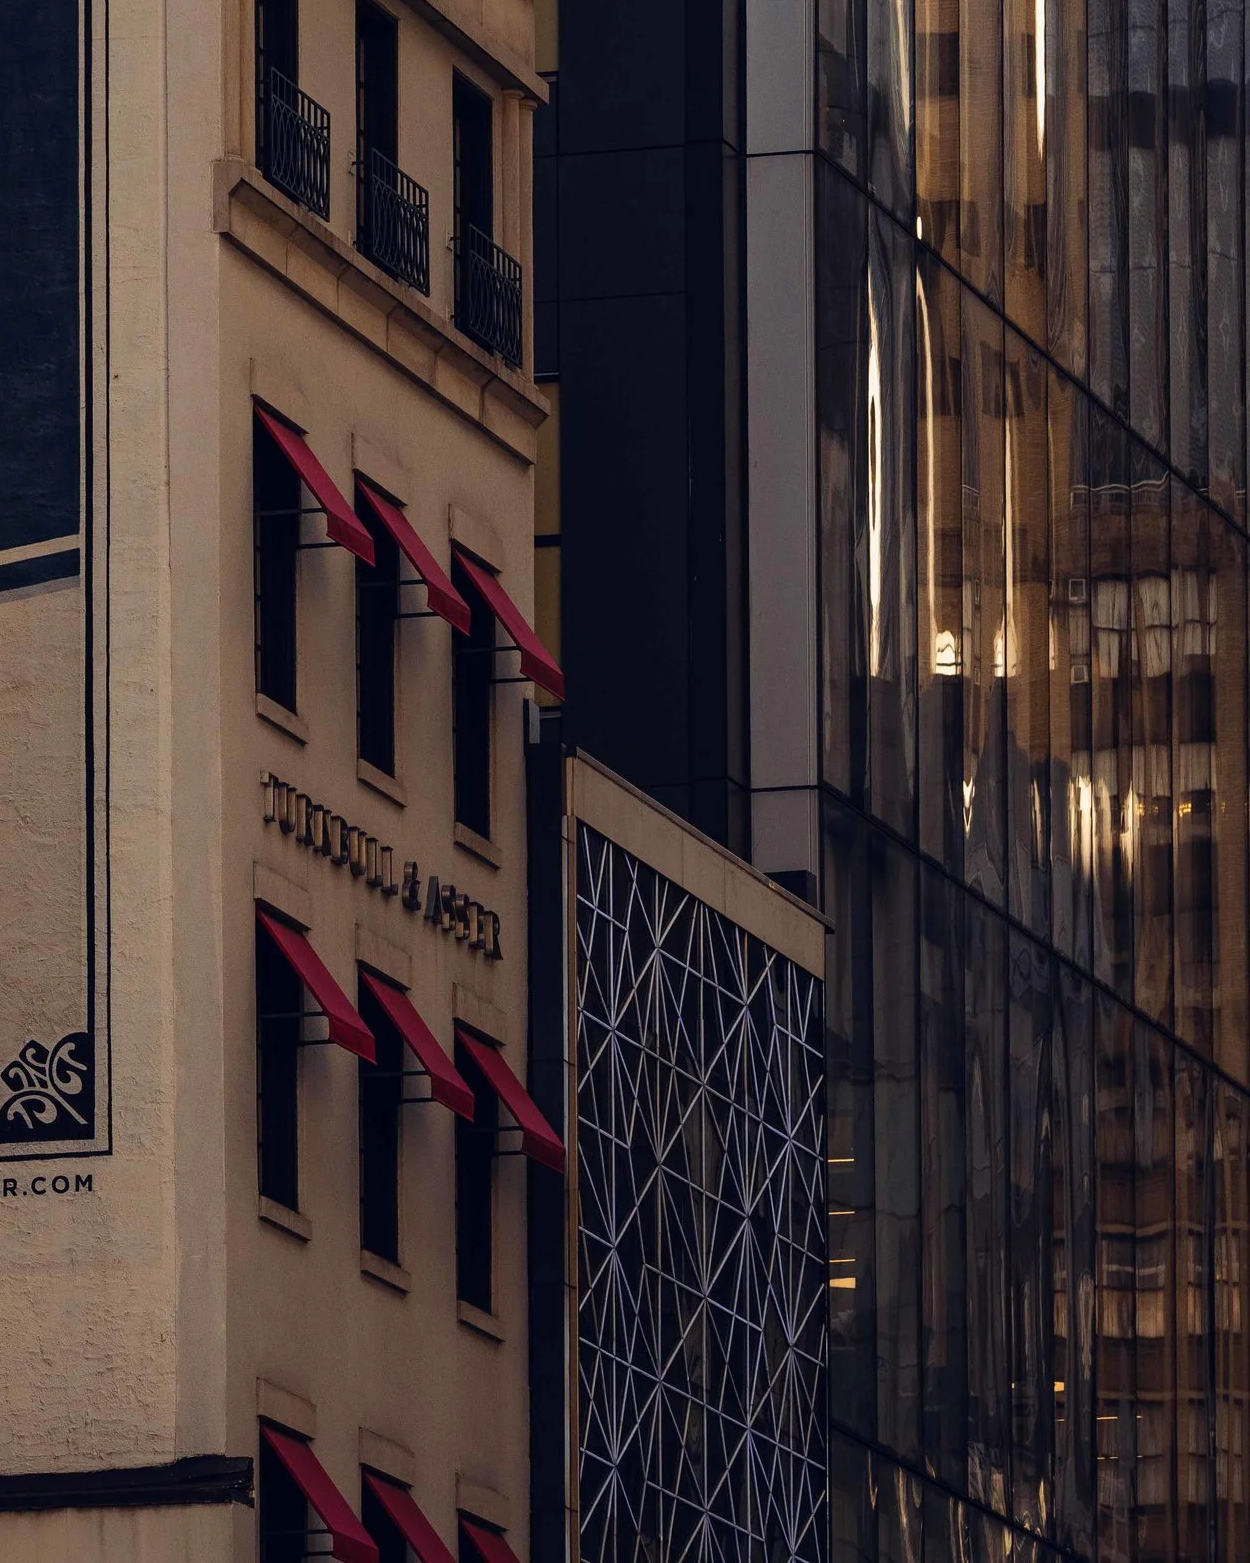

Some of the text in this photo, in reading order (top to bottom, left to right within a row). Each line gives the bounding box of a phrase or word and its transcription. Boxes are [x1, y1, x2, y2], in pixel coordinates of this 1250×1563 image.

[260, 771, 503, 960] TURNBULL & ASSER
